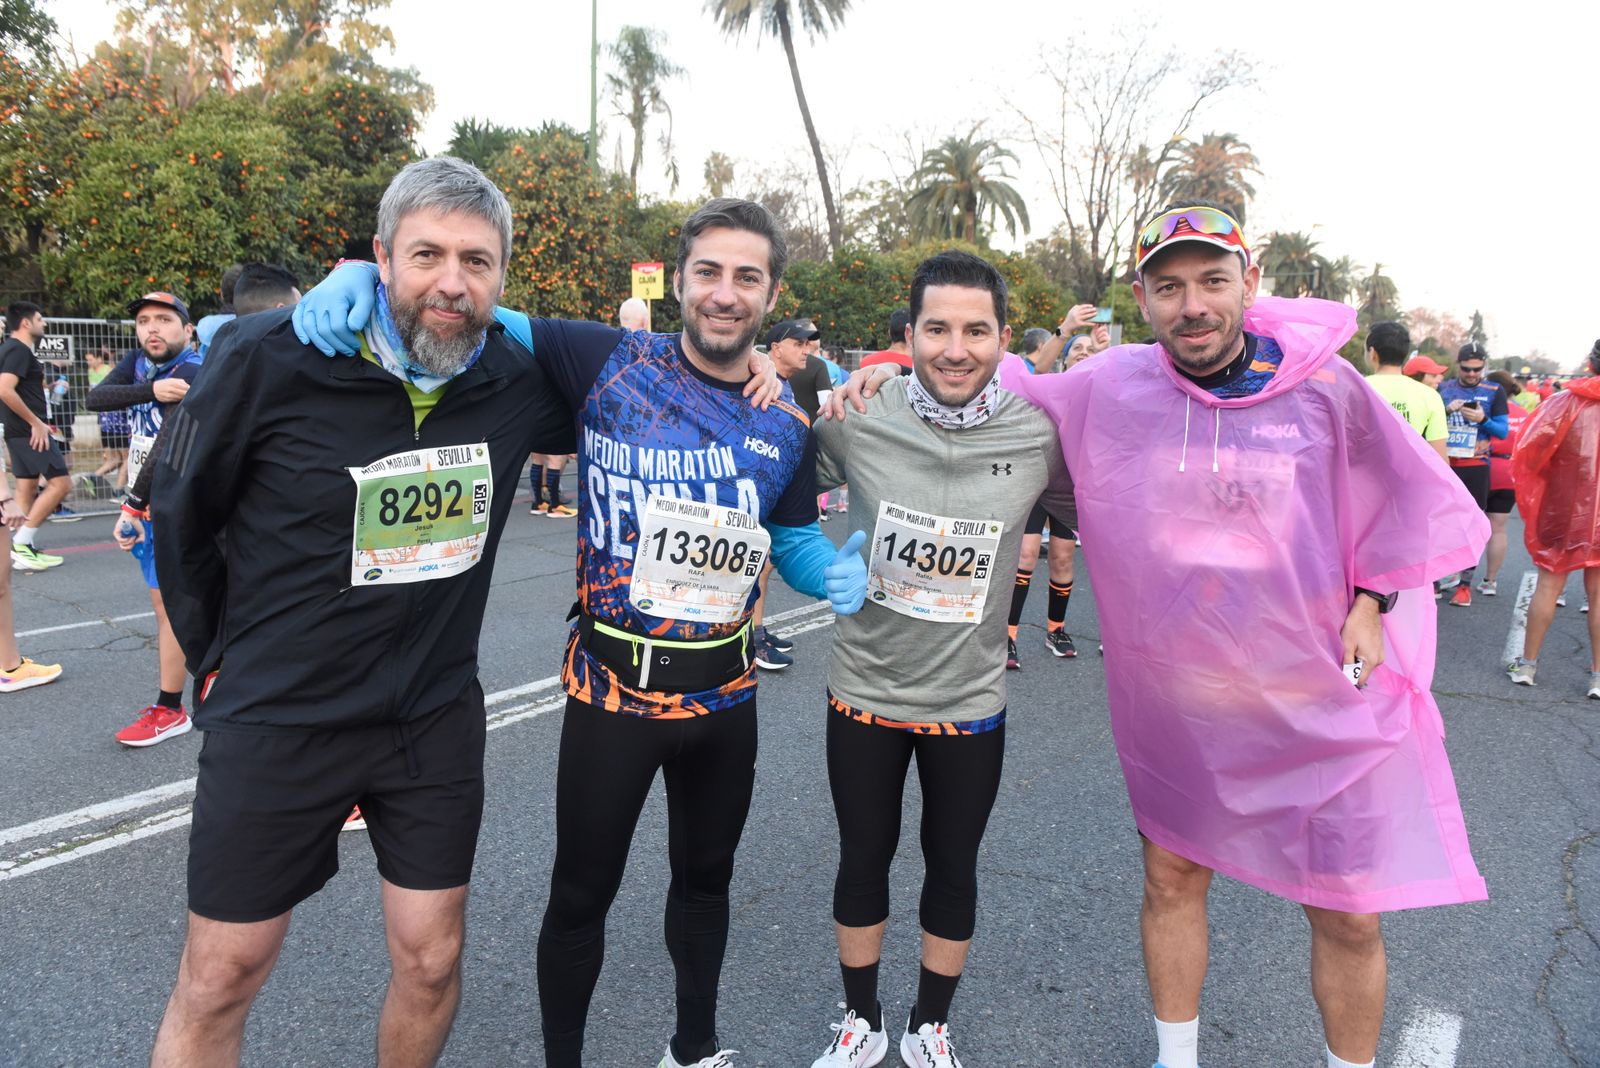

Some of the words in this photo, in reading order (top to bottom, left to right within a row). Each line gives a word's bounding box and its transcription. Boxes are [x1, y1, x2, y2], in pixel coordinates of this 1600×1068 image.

[39, 337, 65, 350] AMS
[1251, 423, 1302, 438] HOKA
[361, 461, 386, 475] MEDIO
[386, 453, 421, 469] MARATÓN
[437, 447, 472, 466] SEVILLA
[584, 425, 631, 475] MEDIO
[638, 441, 737, 480] MARATÓN
[743, 436, 780, 461] HOKA
[379, 479, 464, 526] 8292
[655, 499, 676, 513] MEDIO
[678, 503, 710, 518] MARATÓN
[726, 511, 758, 530] SEVILLA
[886, 506, 905, 520] MEDIO
[906, 512, 937, 529] MARATÓN
[952, 521, 986, 536] SEVILLA
[653, 527, 748, 573] 13308
[883, 532, 976, 577] 14302
[418, 563, 439, 573] HOKA
[688, 568, 705, 577] RAFA
[683, 607, 702, 615] HOKA
[912, 606, 931, 615] HOKA
